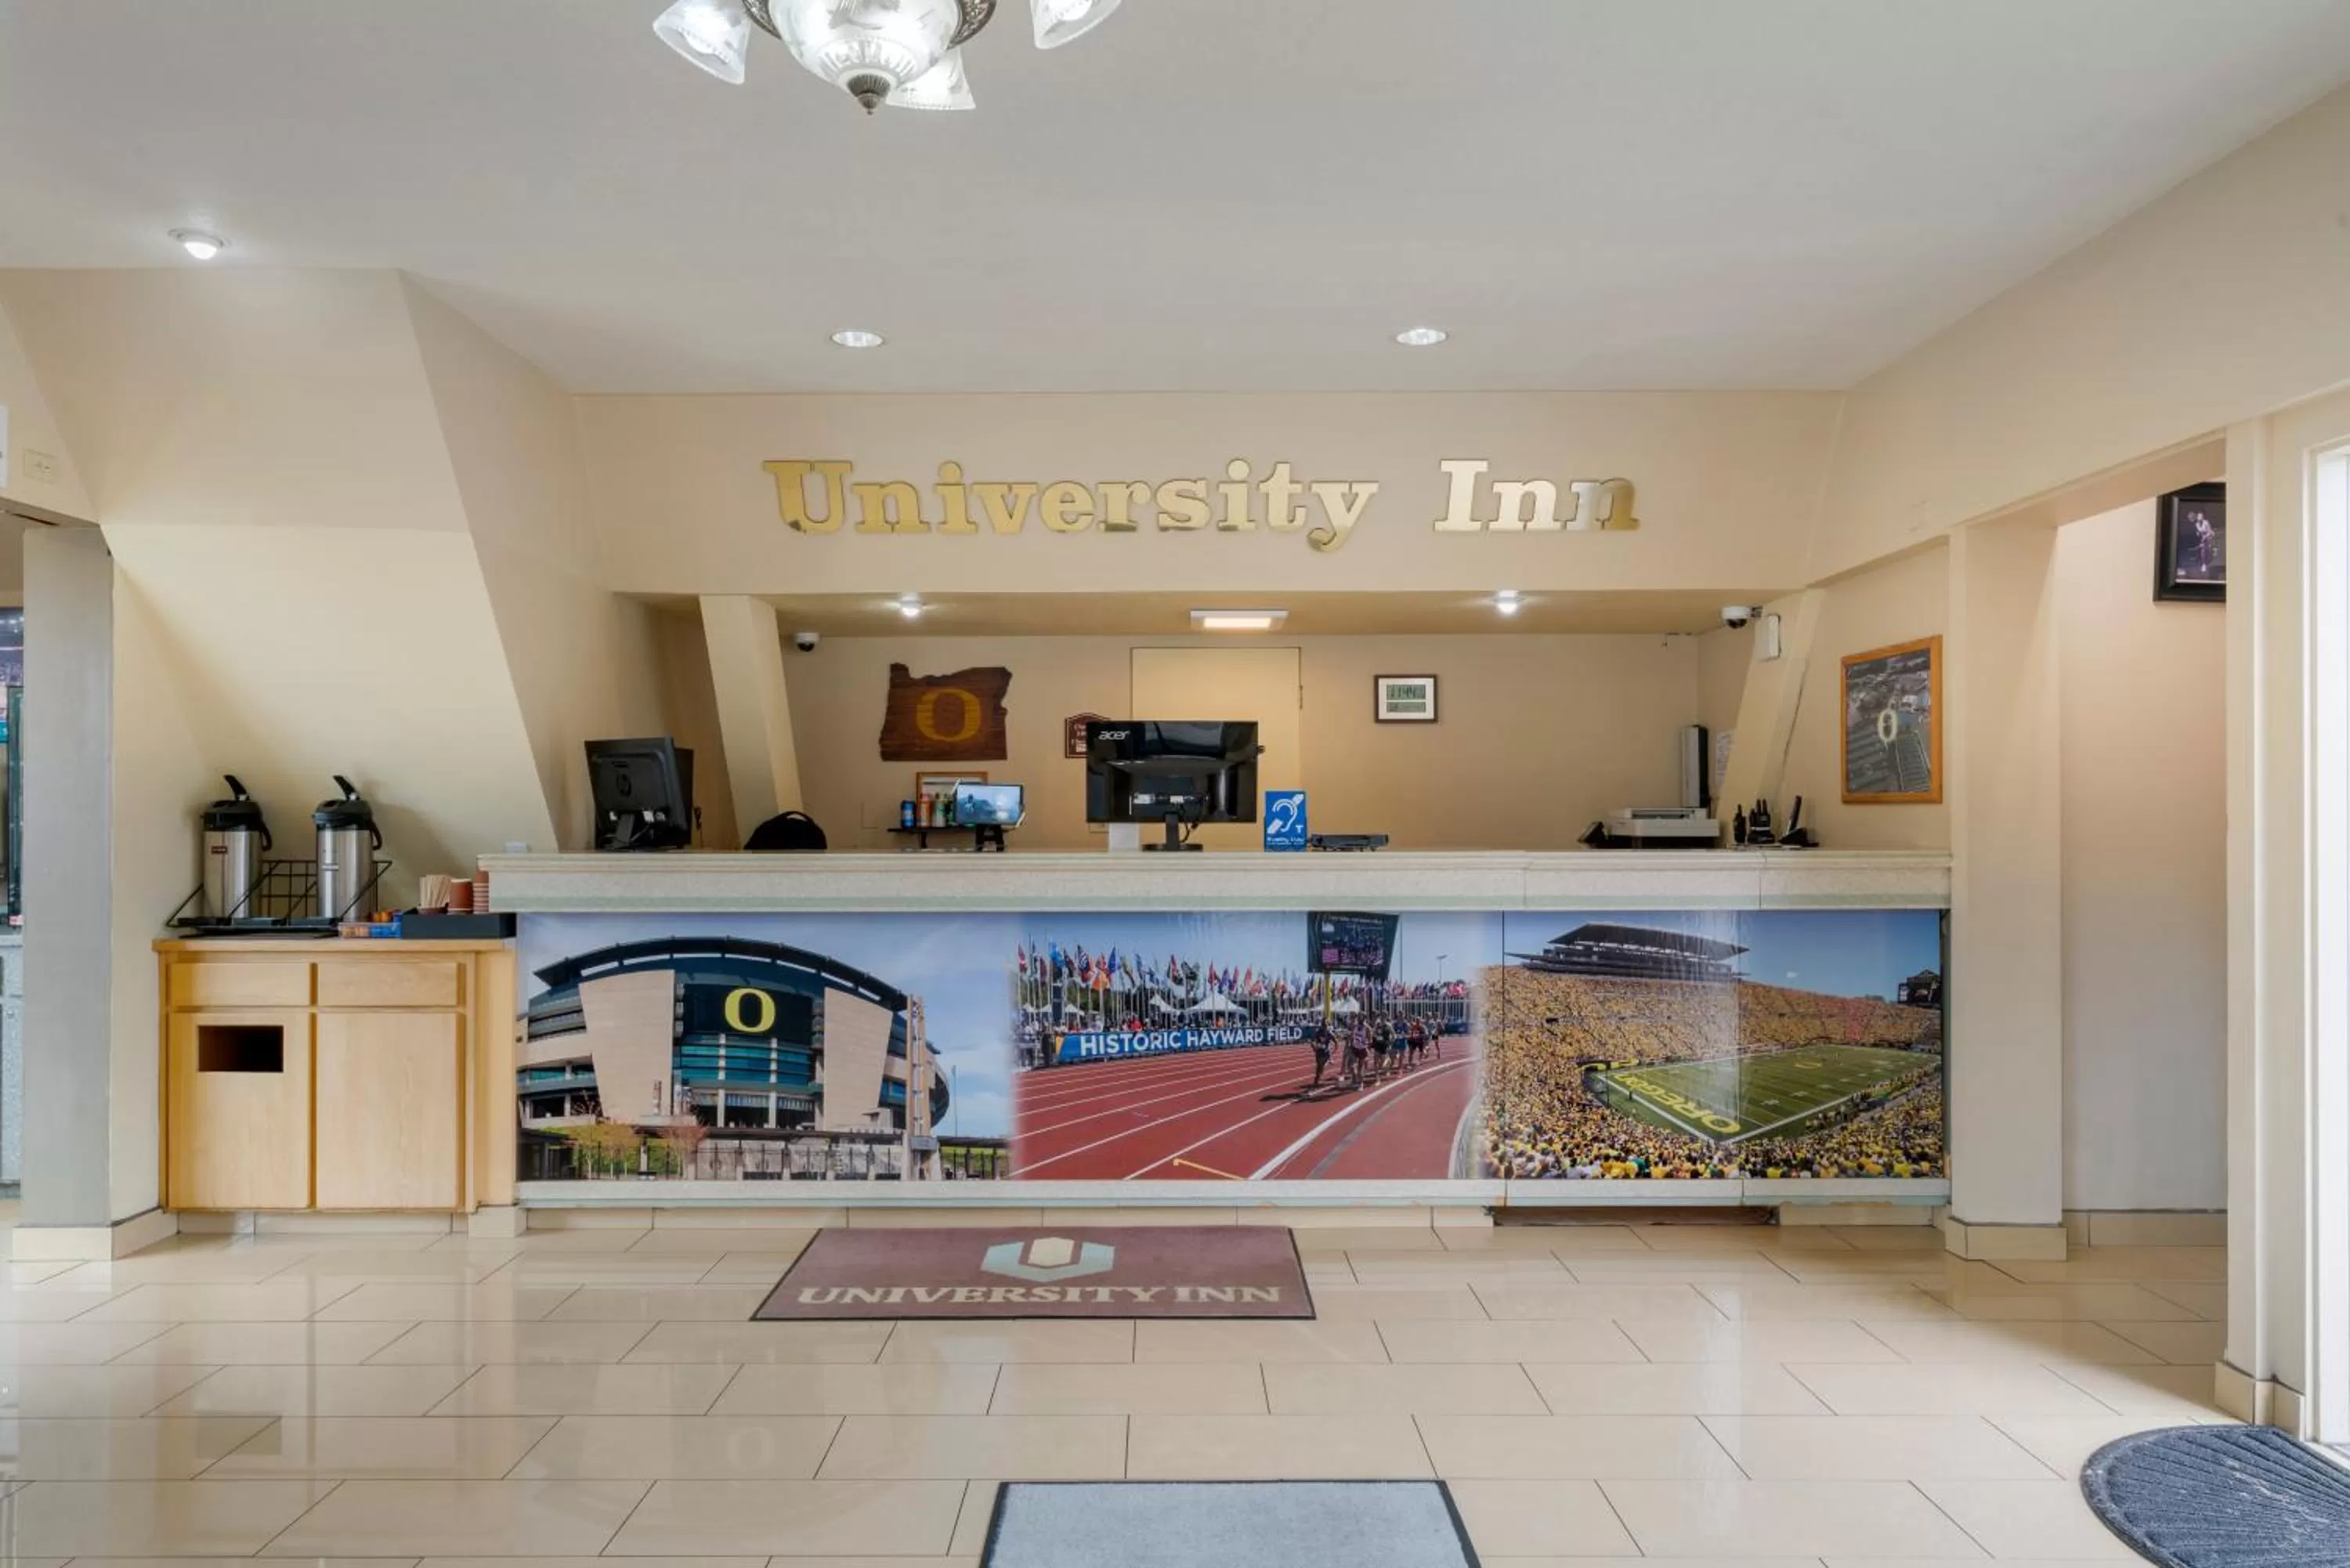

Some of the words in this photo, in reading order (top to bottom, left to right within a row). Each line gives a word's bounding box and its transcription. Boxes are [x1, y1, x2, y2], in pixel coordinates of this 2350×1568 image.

[763, 460, 1379, 553] University
[1433, 458, 1641, 533] Inn
[916, 686, 982, 742] O
[1098, 730, 1131, 740] acer
[1295, 825, 1304, 834] T
[725, 987, 776, 1034] O
[1080, 1031, 1182, 1057] HISTORIC
[1187, 1027, 1264, 1047] HAYWARD
[1267, 1027, 1303, 1042] FIELD
[797, 1286, 1166, 1304] UNIVERSITY
[1174, 1286, 1280, 1303] INN
